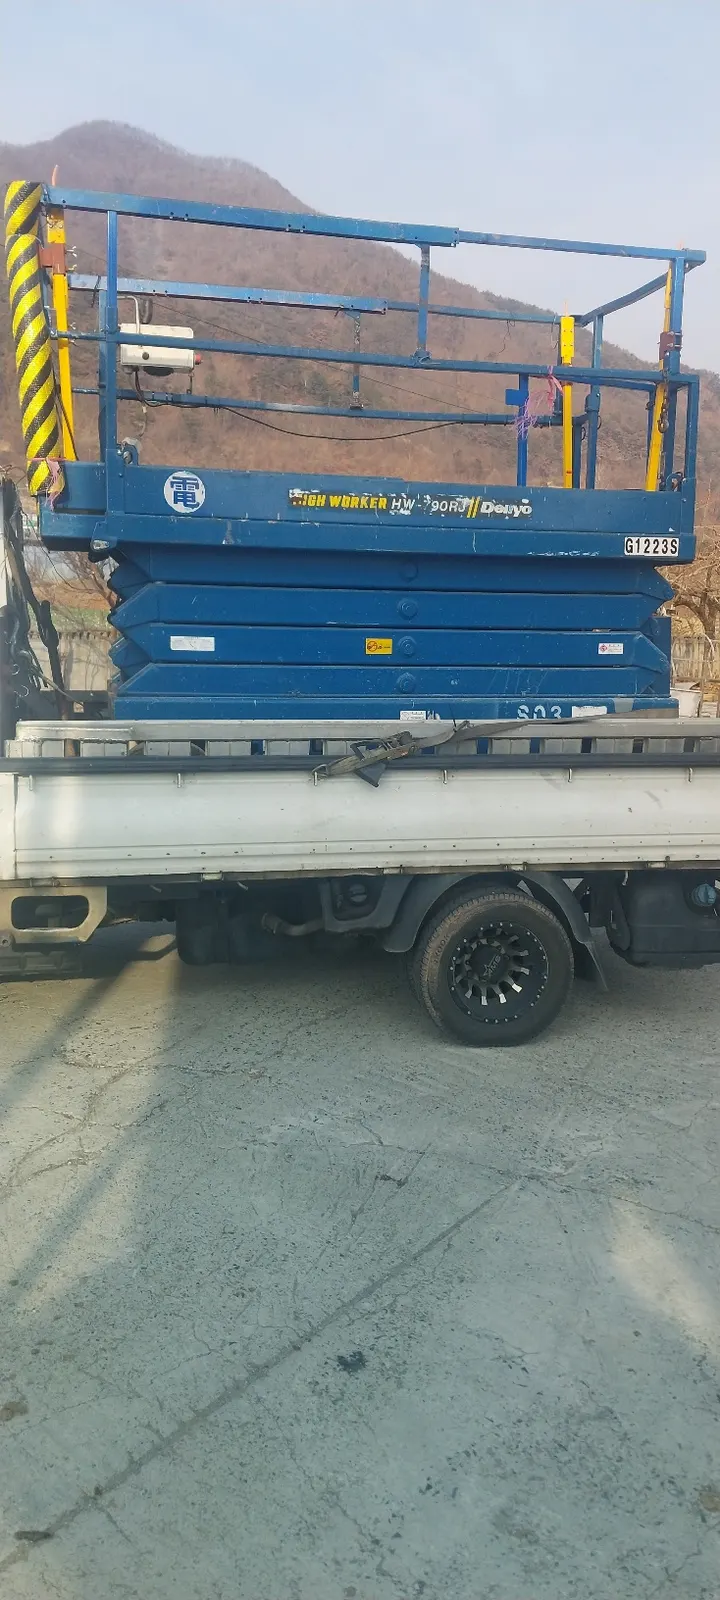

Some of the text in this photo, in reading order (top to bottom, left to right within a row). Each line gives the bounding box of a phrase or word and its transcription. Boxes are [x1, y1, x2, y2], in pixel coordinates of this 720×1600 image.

[170, 475, 200, 510] 電
[328, 495, 388, 510] WORKER
[625, 538, 678, 555] G1223S
